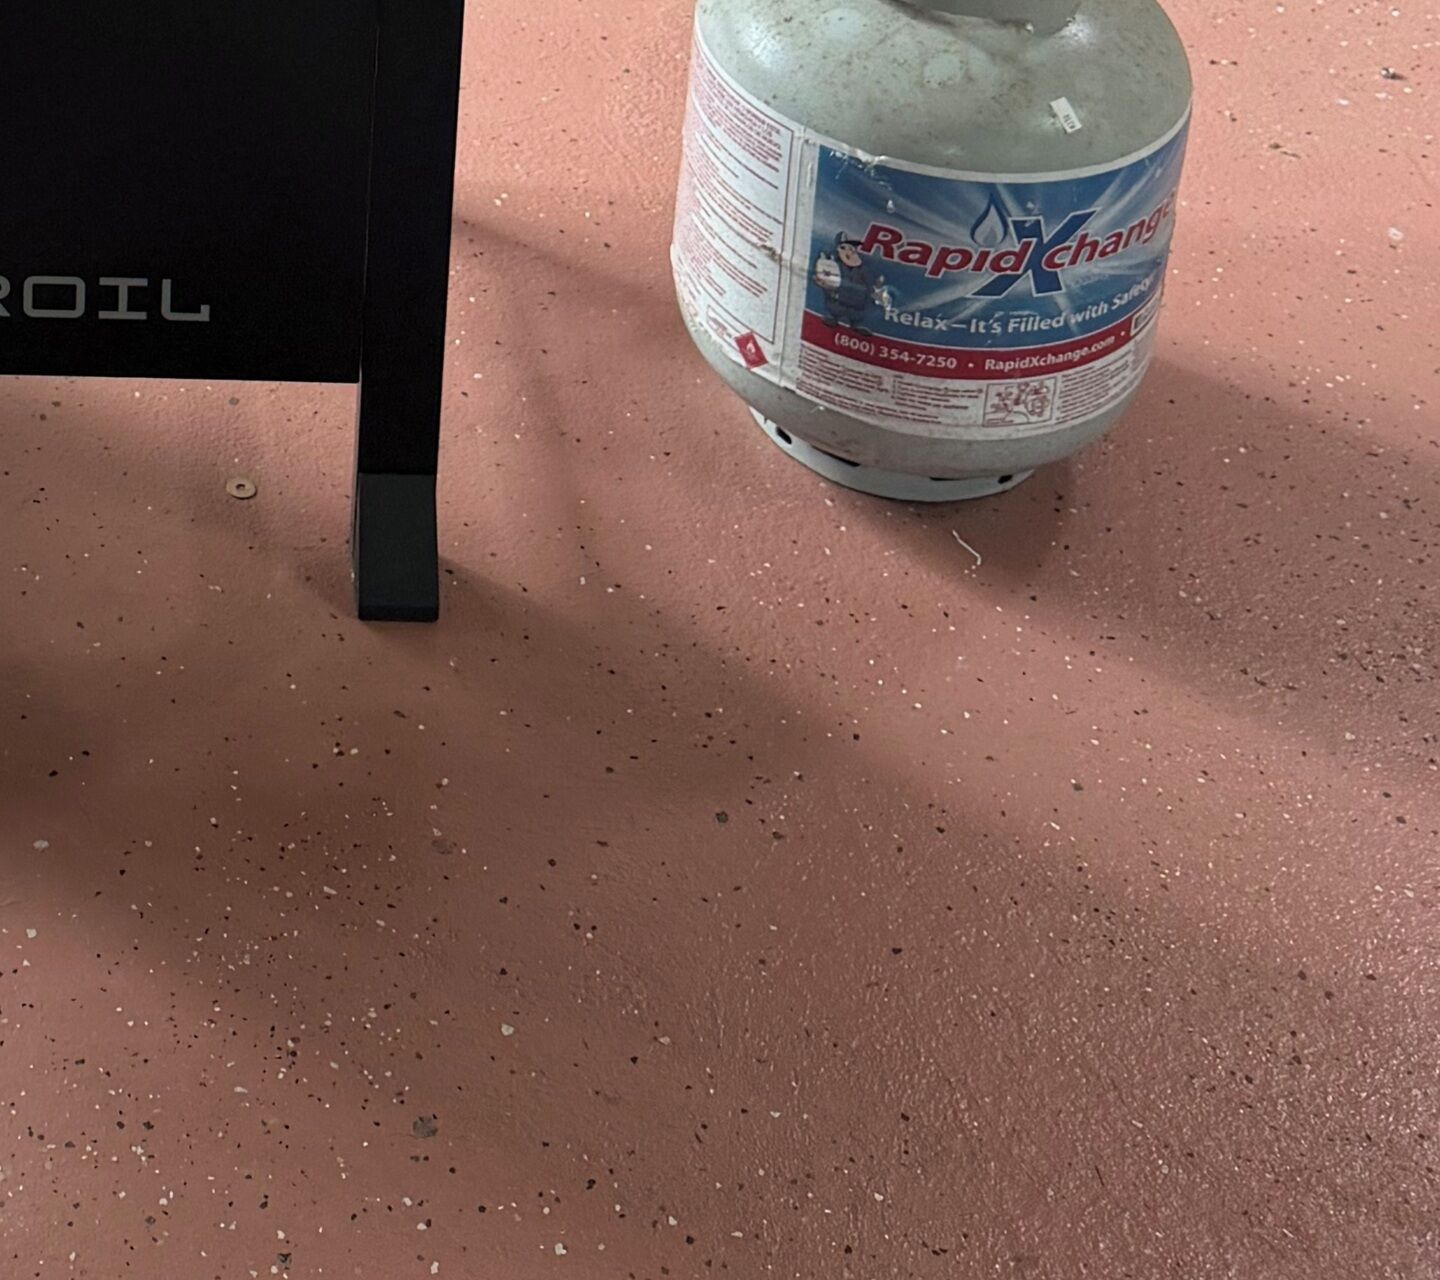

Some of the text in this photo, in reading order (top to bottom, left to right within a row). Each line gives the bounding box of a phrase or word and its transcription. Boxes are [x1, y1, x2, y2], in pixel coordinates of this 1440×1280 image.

[1007, 311, 1066, 334] Filled
[1068, 301, 1109, 325] with
[834, 332, 1117, 372] (800) 354-7250 RapidXchange.com
